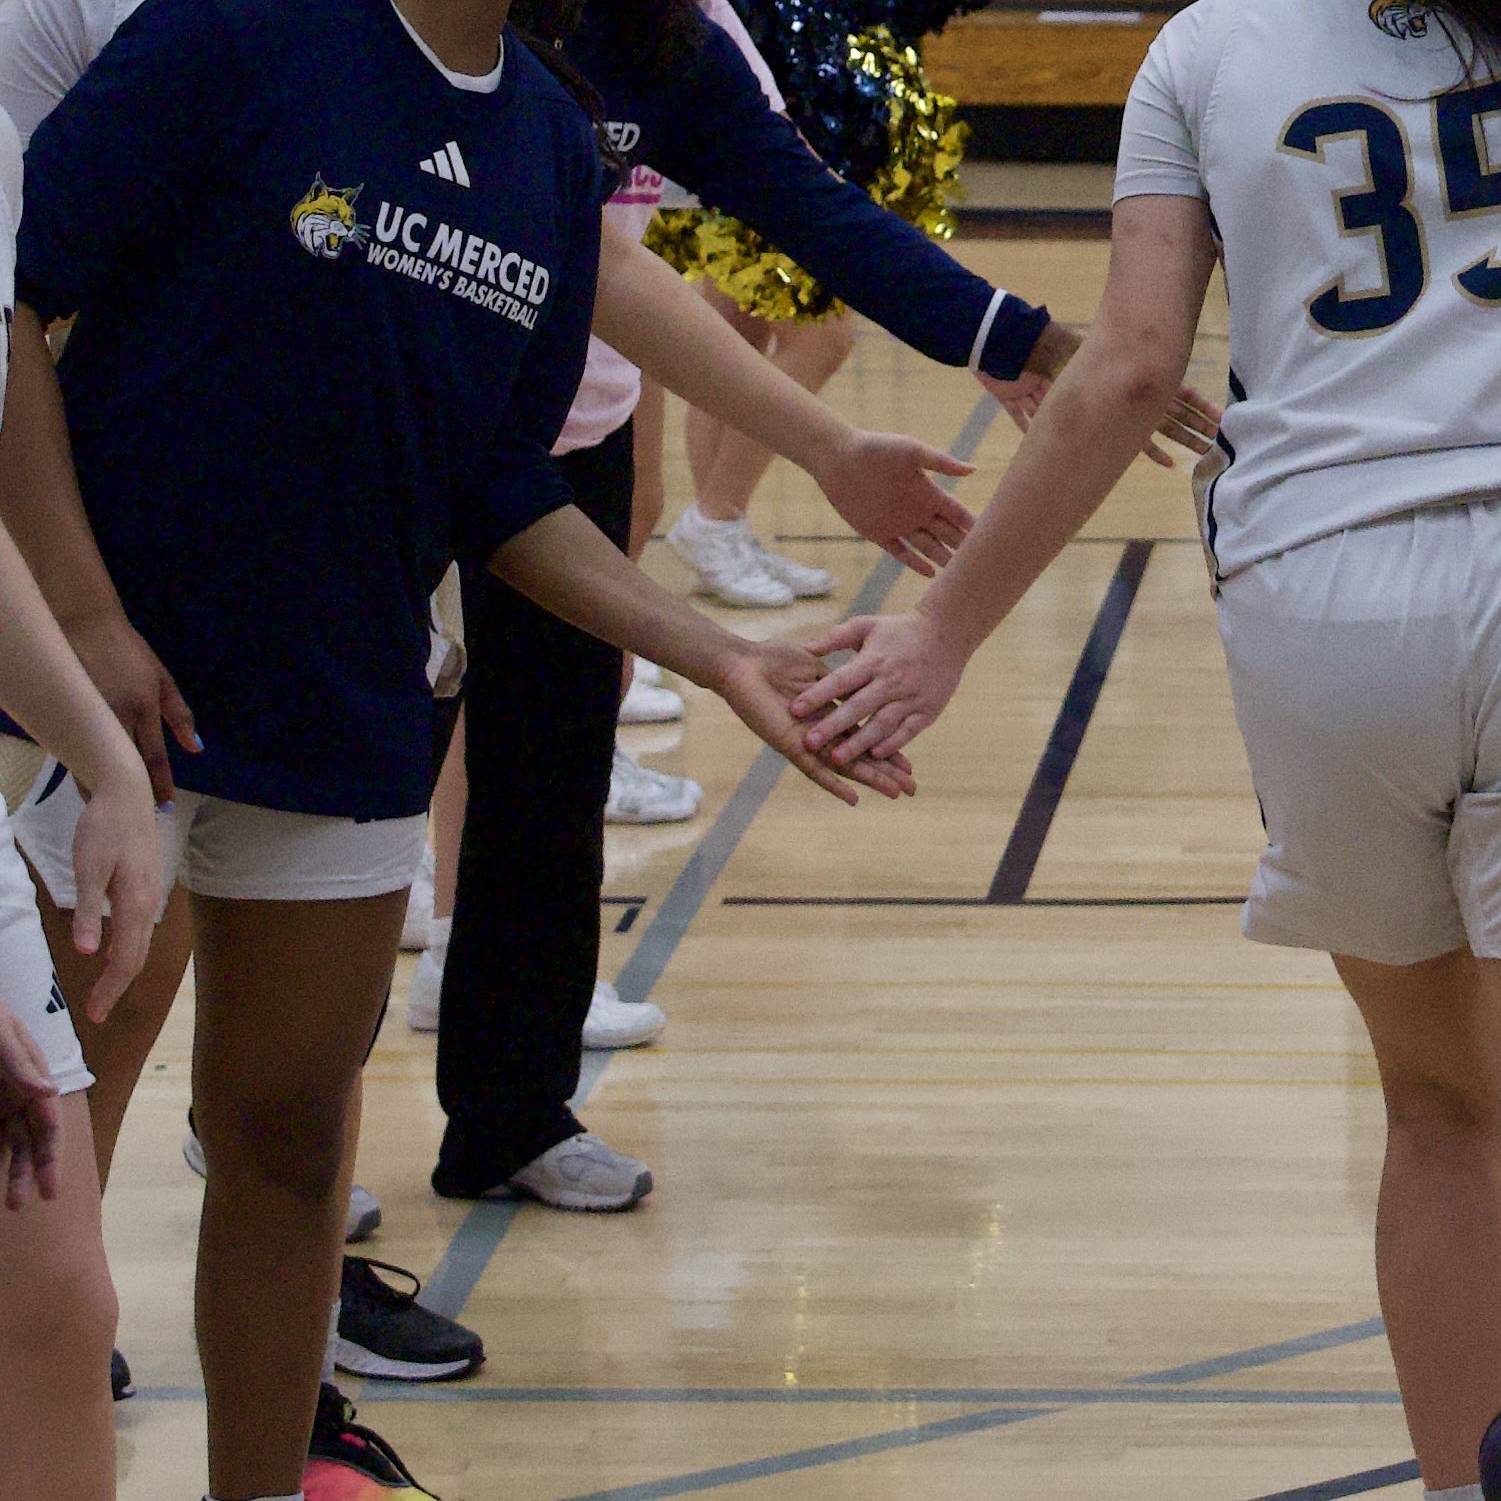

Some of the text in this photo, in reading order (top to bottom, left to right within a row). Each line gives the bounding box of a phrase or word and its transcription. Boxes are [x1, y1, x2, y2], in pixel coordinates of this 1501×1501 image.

[367, 242, 539, 330] WOMEN'S BASKETBALL
[376, 201, 550, 305] UC MERCED
